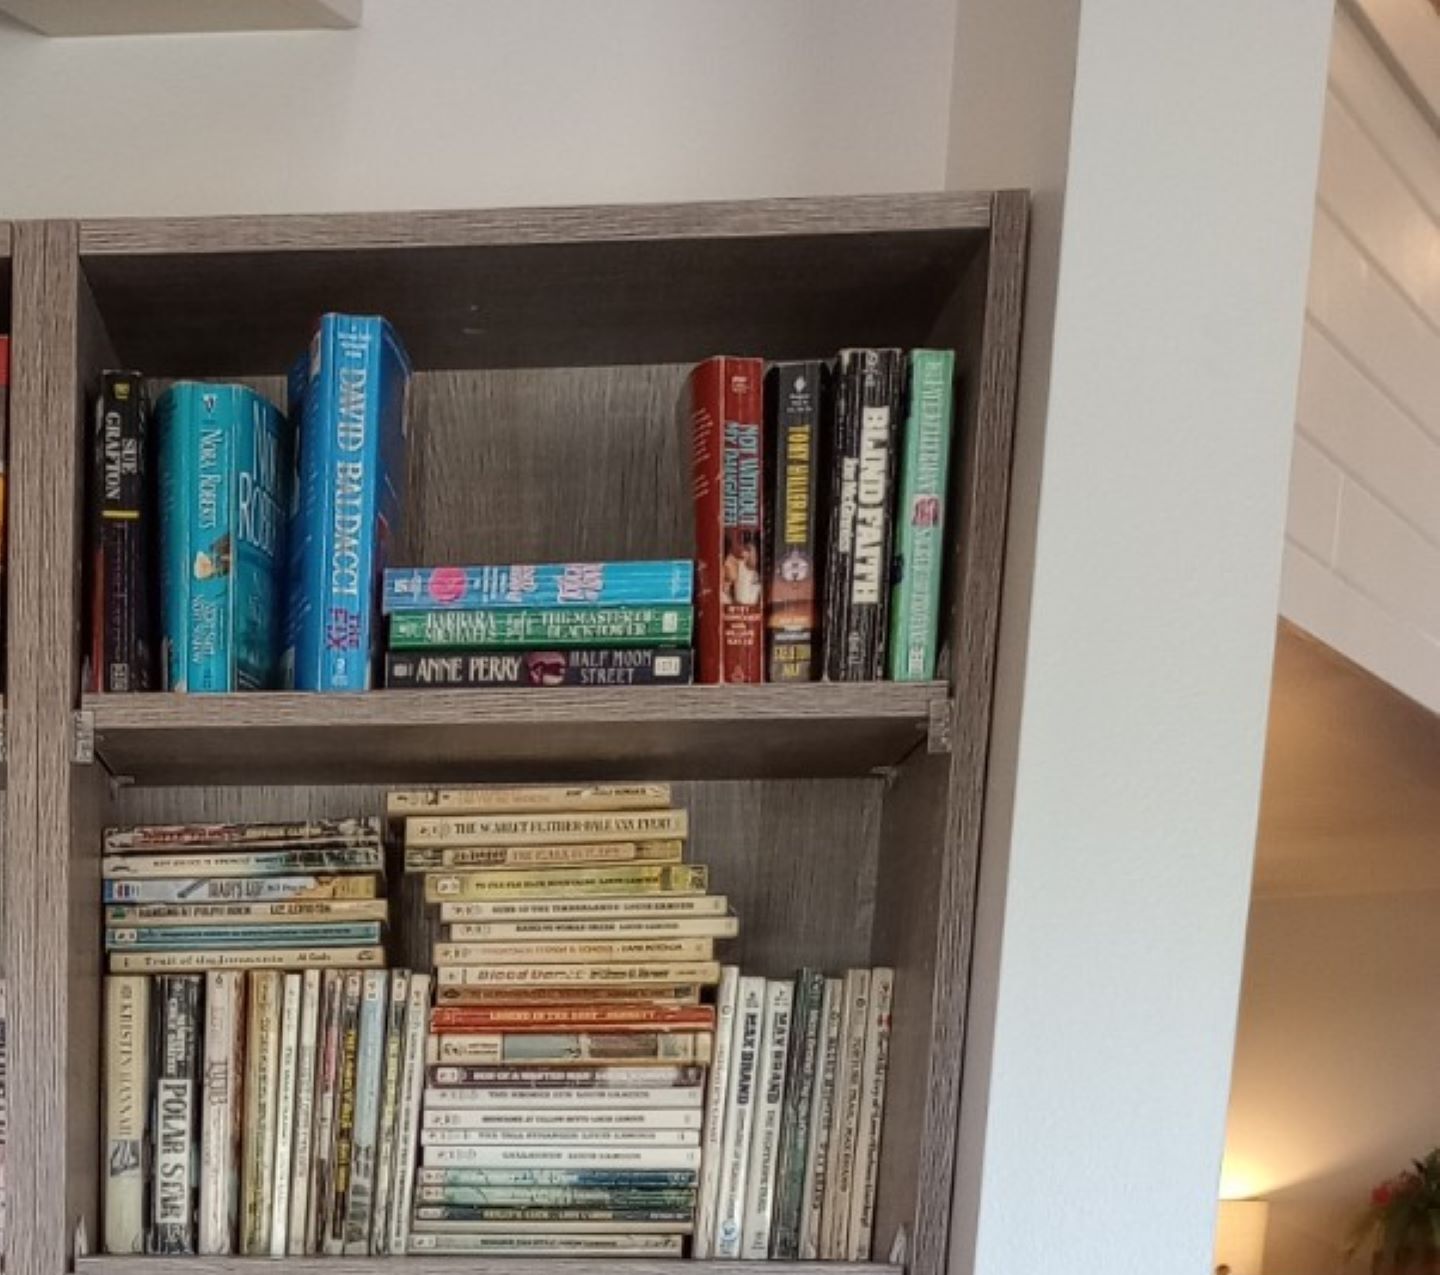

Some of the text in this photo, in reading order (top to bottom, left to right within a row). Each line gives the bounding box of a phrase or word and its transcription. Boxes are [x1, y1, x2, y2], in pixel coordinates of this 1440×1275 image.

[104, 411, 121, 501] GRAFTON
[121, 438, 138, 475] SUE
[198, 428, 222, 530] NORA ROBERTS
[333, 368, 367, 598] DAVID BALDACCI
[738, 458, 759, 527] WITHOUT
[784, 425, 811, 544] TONY HILLERMAN
[852, 405, 890, 605] BLIND FAITH
[416, 655, 522, 682] ANNE PERRY
[570, 650, 652, 667] HALF MOON
[580, 667, 635, 684] STREET
[118, 1003, 133, 1137] KRISTIN HANNAH
[160, 1083, 187, 1221] POLAR STAR
